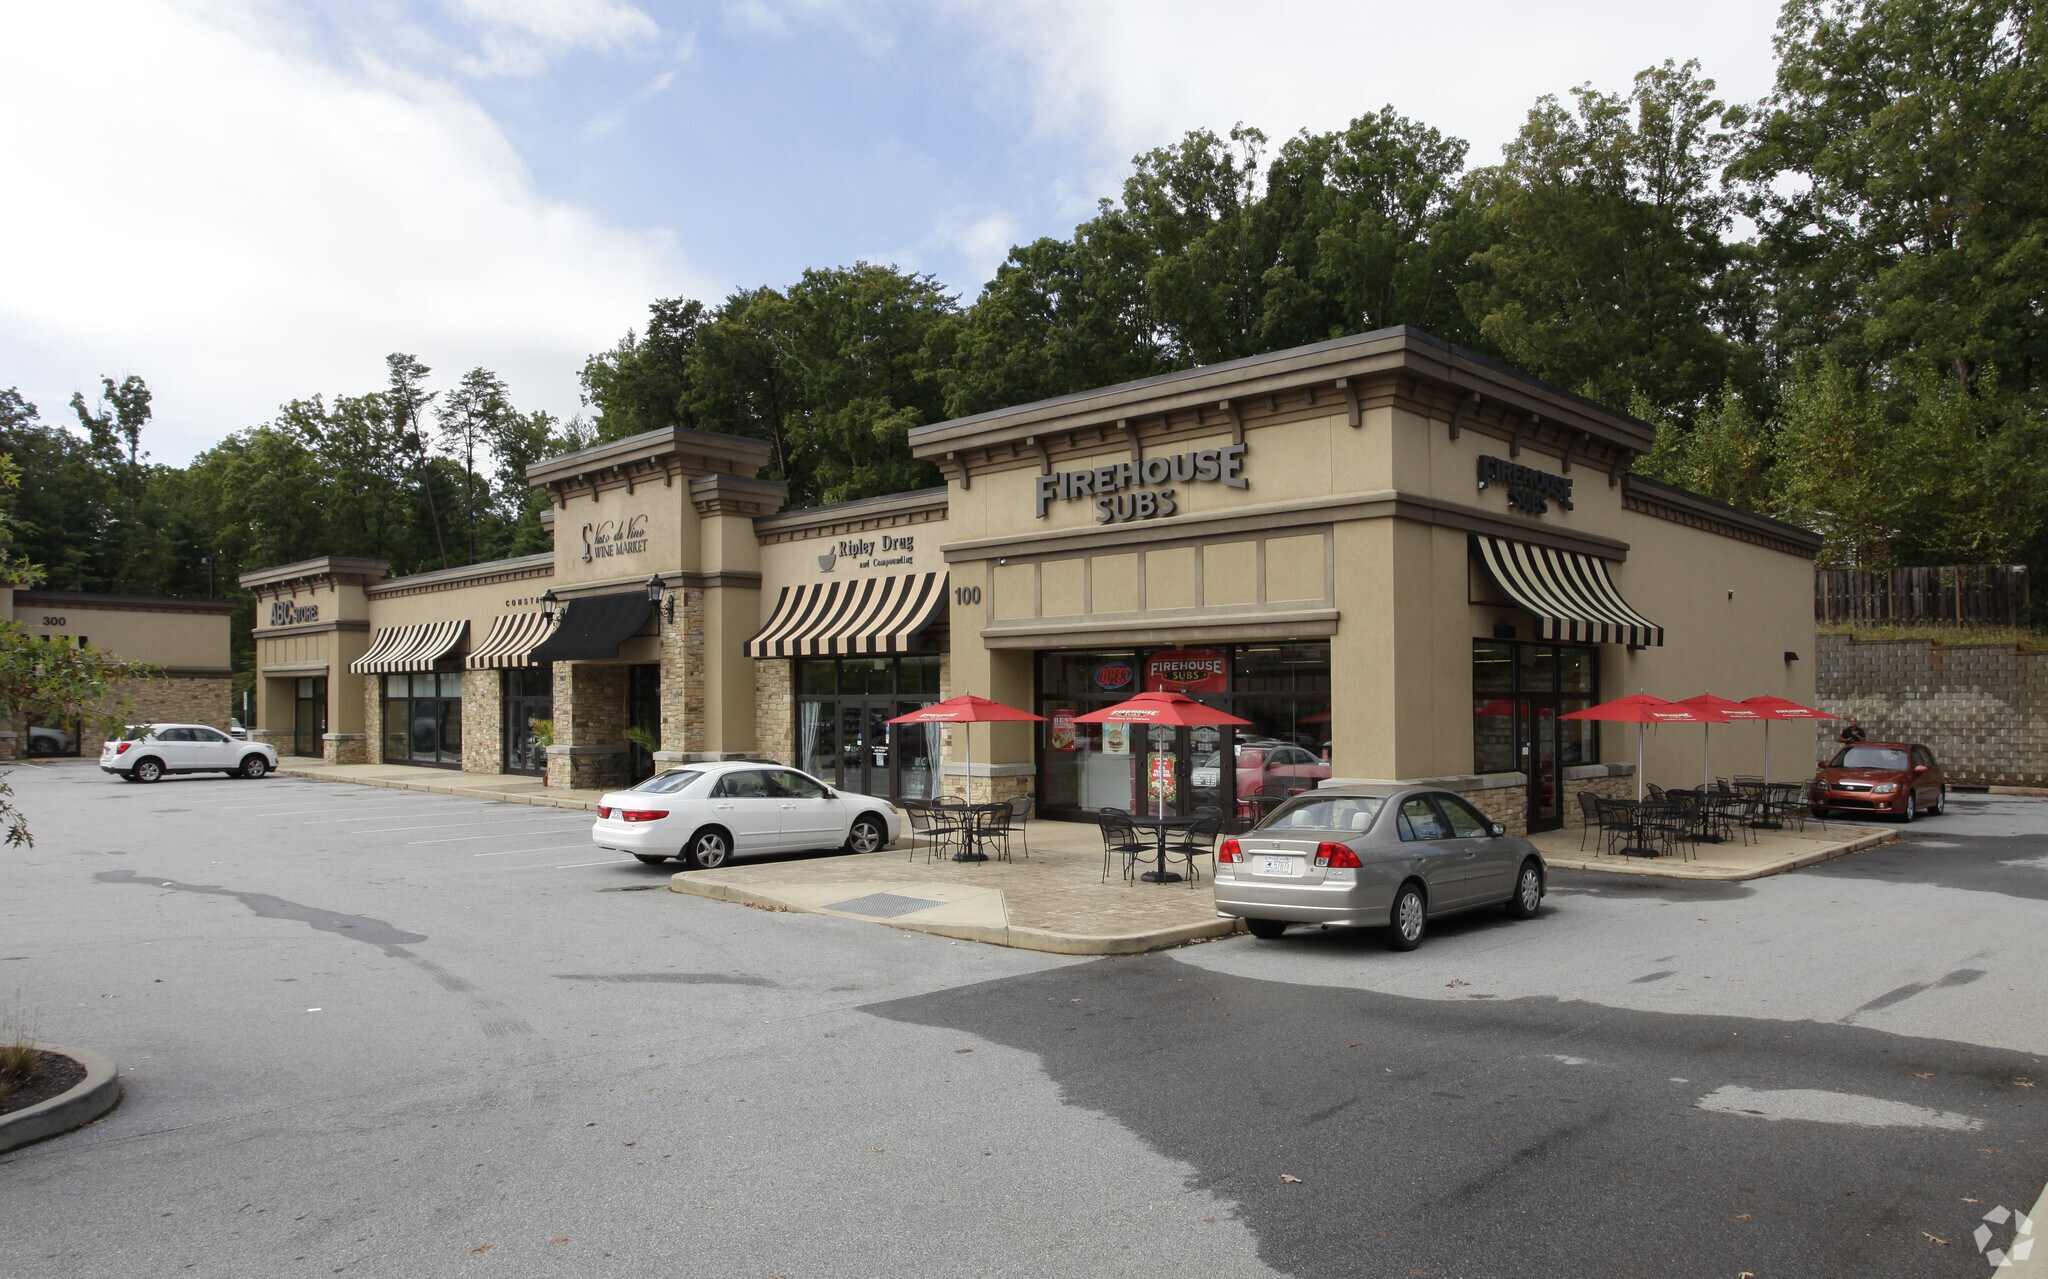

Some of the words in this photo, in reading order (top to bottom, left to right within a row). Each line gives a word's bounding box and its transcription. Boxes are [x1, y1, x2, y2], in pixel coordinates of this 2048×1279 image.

[1035, 442, 1249, 518] FIREHOUSE
[1477, 455, 1573, 511] FIREHOUSE
[1096, 488, 1177, 523] SUBS
[1507, 488, 1548, 513] SUBS
[627, 514, 648, 539] Vino
[594, 544, 614, 559] WINE
[616, 538, 648, 556] MARKET
[838, 538, 875, 558] Ripley
[881, 535, 914, 551] Drug
[873, 556, 914, 568] Compounding
[505, 596, 540, 607] CONSTA
[954, 586, 981, 605] 100
[42, 616, 66, 627] 300
[270, 600, 293, 626] ABC
[293, 604, 319, 622] STORE
[1099, 667, 1129, 685] OPEN
[1151, 660, 1222, 677] FIREHOUSE
[1172, 671, 1199, 680] SUBS
